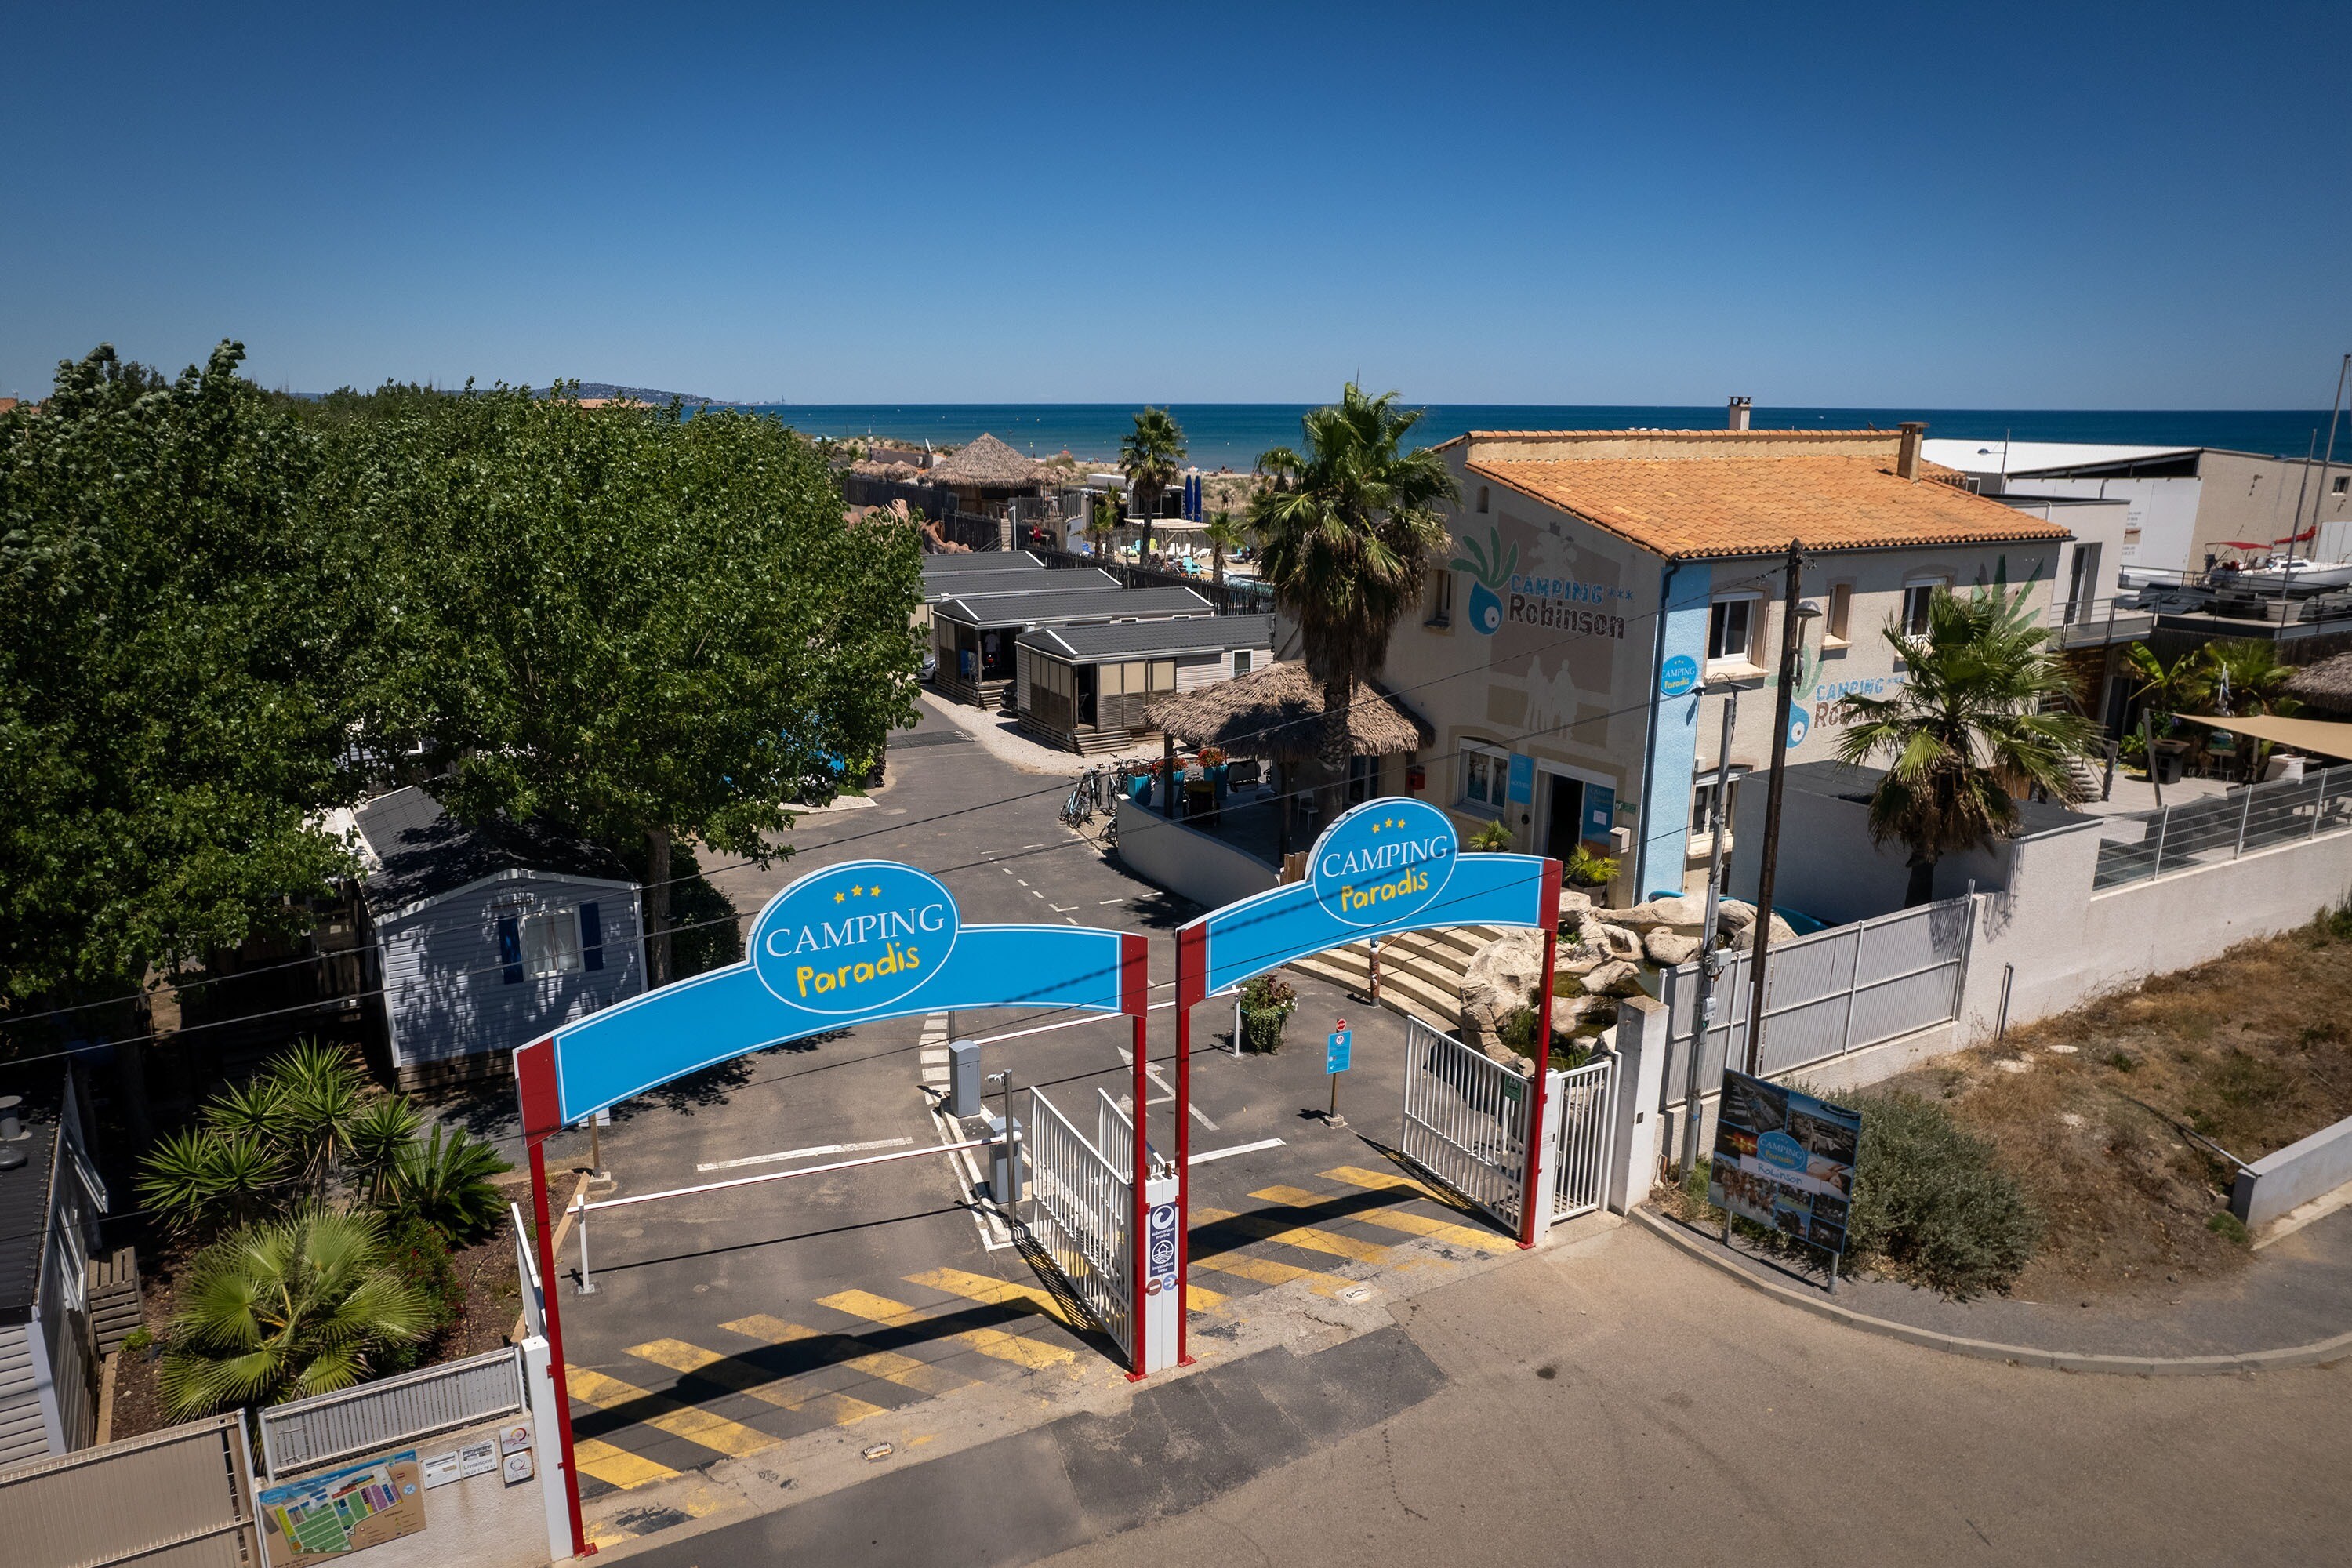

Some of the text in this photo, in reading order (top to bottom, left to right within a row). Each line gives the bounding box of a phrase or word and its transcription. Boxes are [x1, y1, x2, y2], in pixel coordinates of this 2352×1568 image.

[1510, 575, 1603, 604] CAMPING
[1508, 593, 1626, 640] Robinson
[1662, 666, 1696, 678] CAMPING
[1664, 677, 1690, 689] Paradis
[1816, 677, 1884, 701] CAMPING
[1322, 835, 1448, 878] CAMPING
[1341, 868, 1428, 913] Paradis
[765, 904, 945, 958] CAMPING
[797, 942, 920, 998] Paradis
[1759, 1138, 1802, 1160] CAMPING
[1152, 1227, 1174, 1236] submersion
[1152, 1261, 1174, 1271] inondation
[463, 1459, 493, 1470] Livraisons
